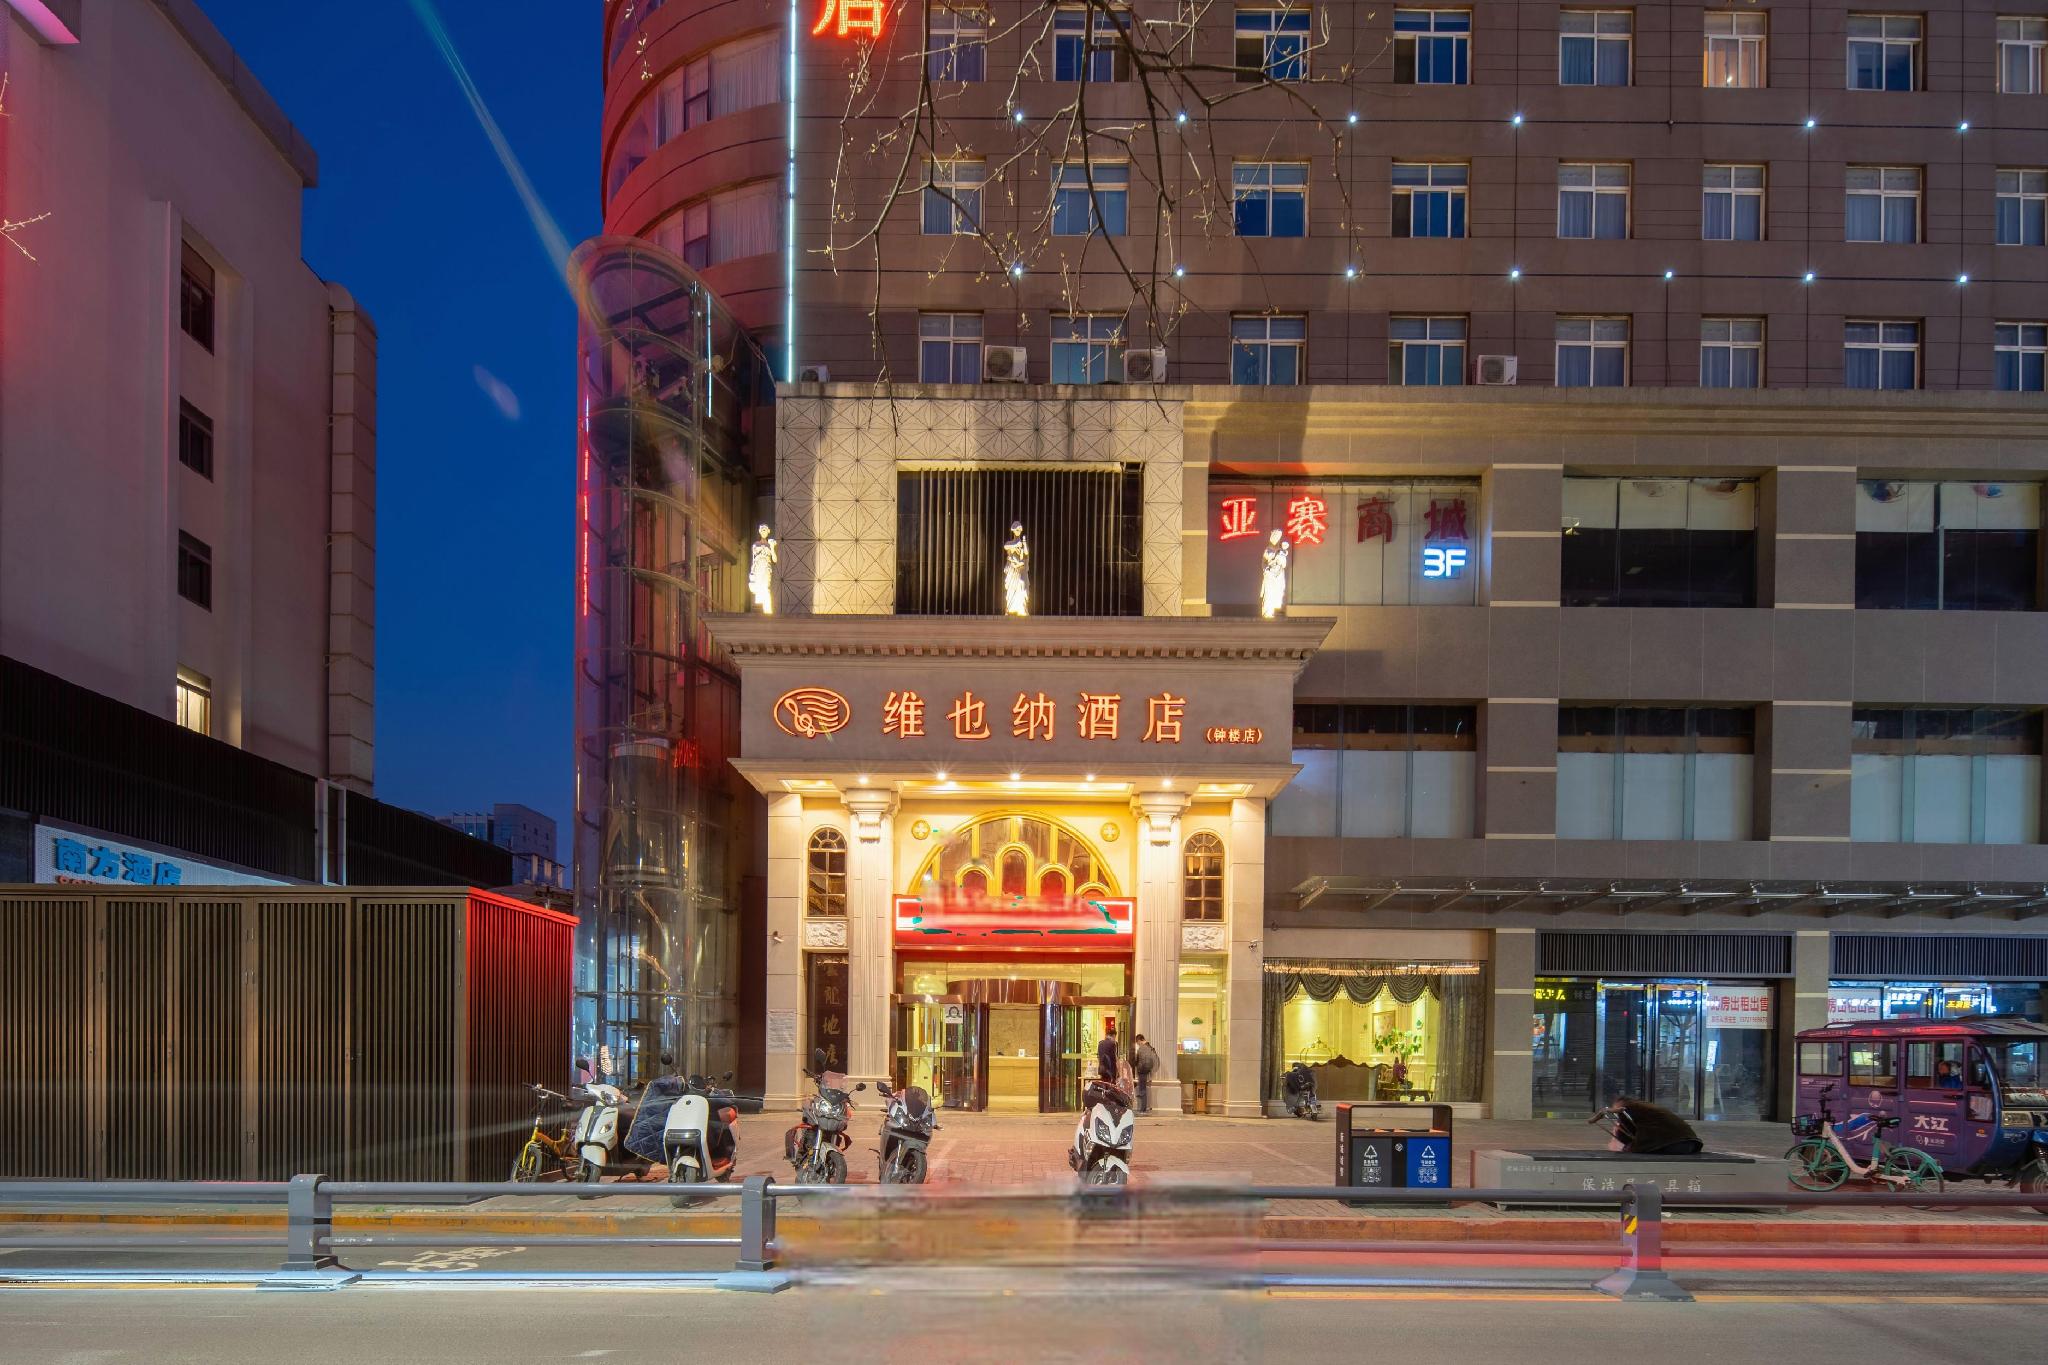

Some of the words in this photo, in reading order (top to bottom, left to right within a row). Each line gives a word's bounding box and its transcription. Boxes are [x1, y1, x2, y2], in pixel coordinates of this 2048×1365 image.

[1220, 496, 1469, 544] 亚赛商城
[1423, 548, 1467, 577] 3F
[883, 691, 1186, 743] 维也纳酒店
[54, 837, 182, 885] 南方酒店
[1914, 1115, 1949, 1131] 大江
[1582, 1177, 1702, 1193] 保洁具箱
